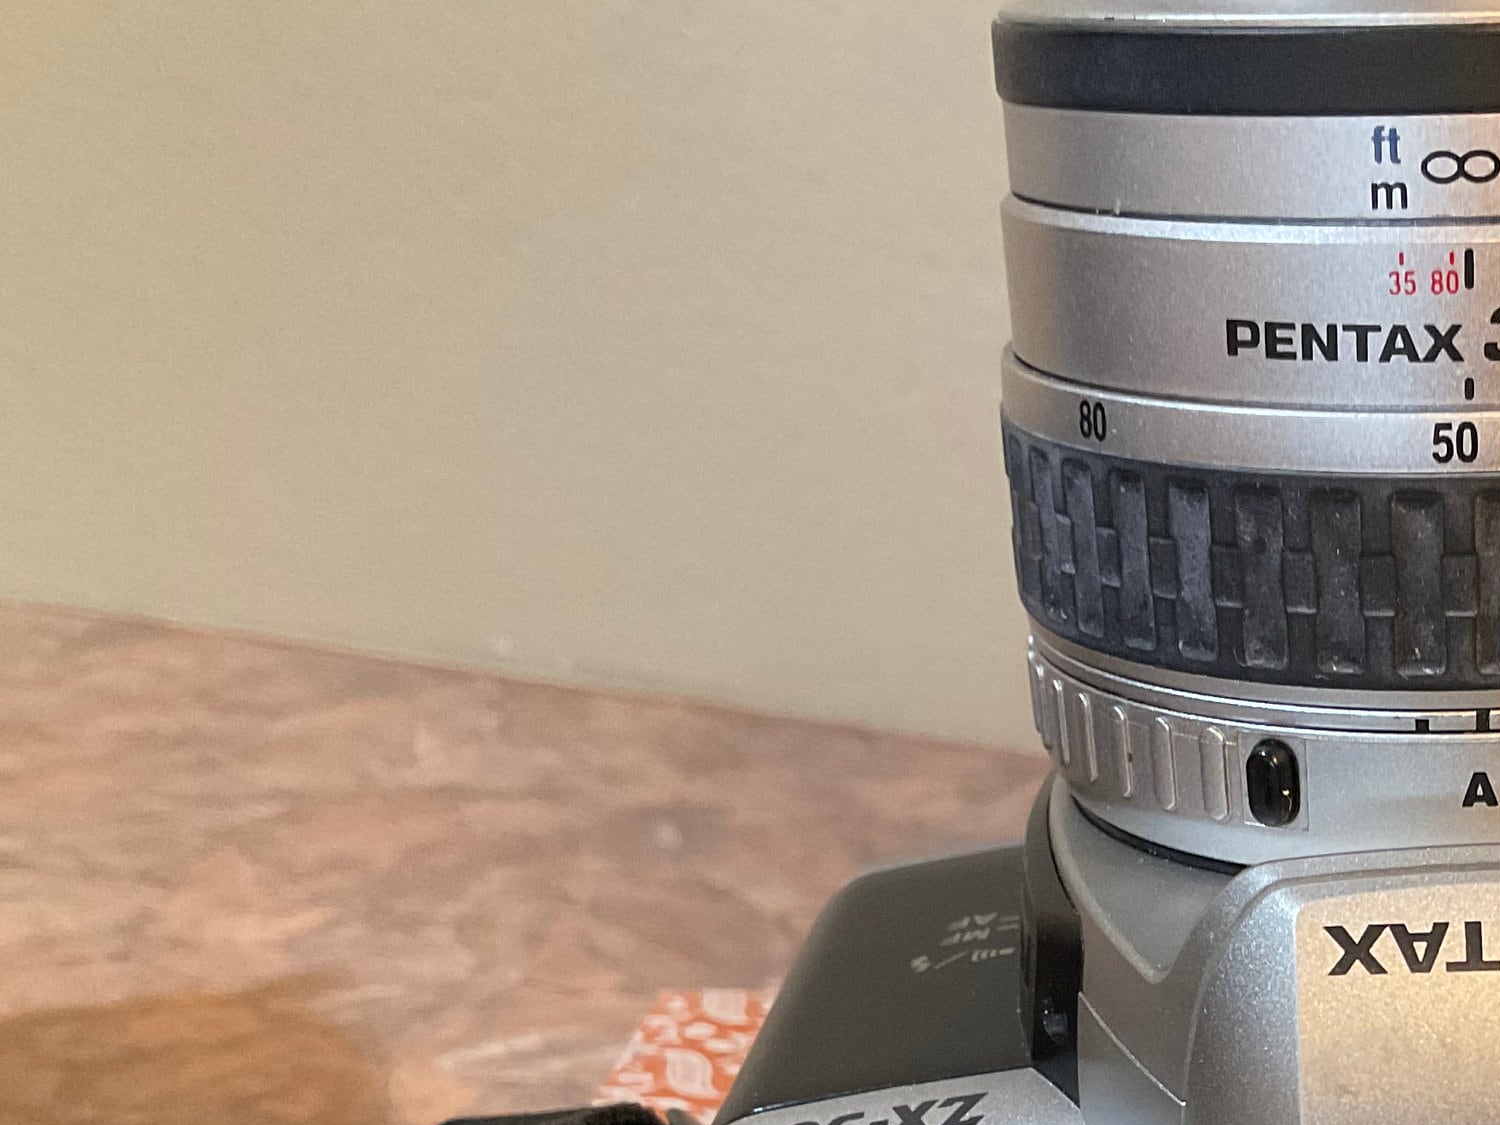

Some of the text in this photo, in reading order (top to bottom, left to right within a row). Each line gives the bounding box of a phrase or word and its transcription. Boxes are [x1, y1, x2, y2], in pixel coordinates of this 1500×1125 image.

[1371, 125, 1401, 164] ft
[1371, 181, 1408, 210] m
[1388, 270, 1459, 295] 35 80
[1225, 319, 1465, 363] PENTAX
[1079, 401, 1107, 441] 80
[1431, 421, 1479, 464] 50
[1462, 772, 1498, 807] A
